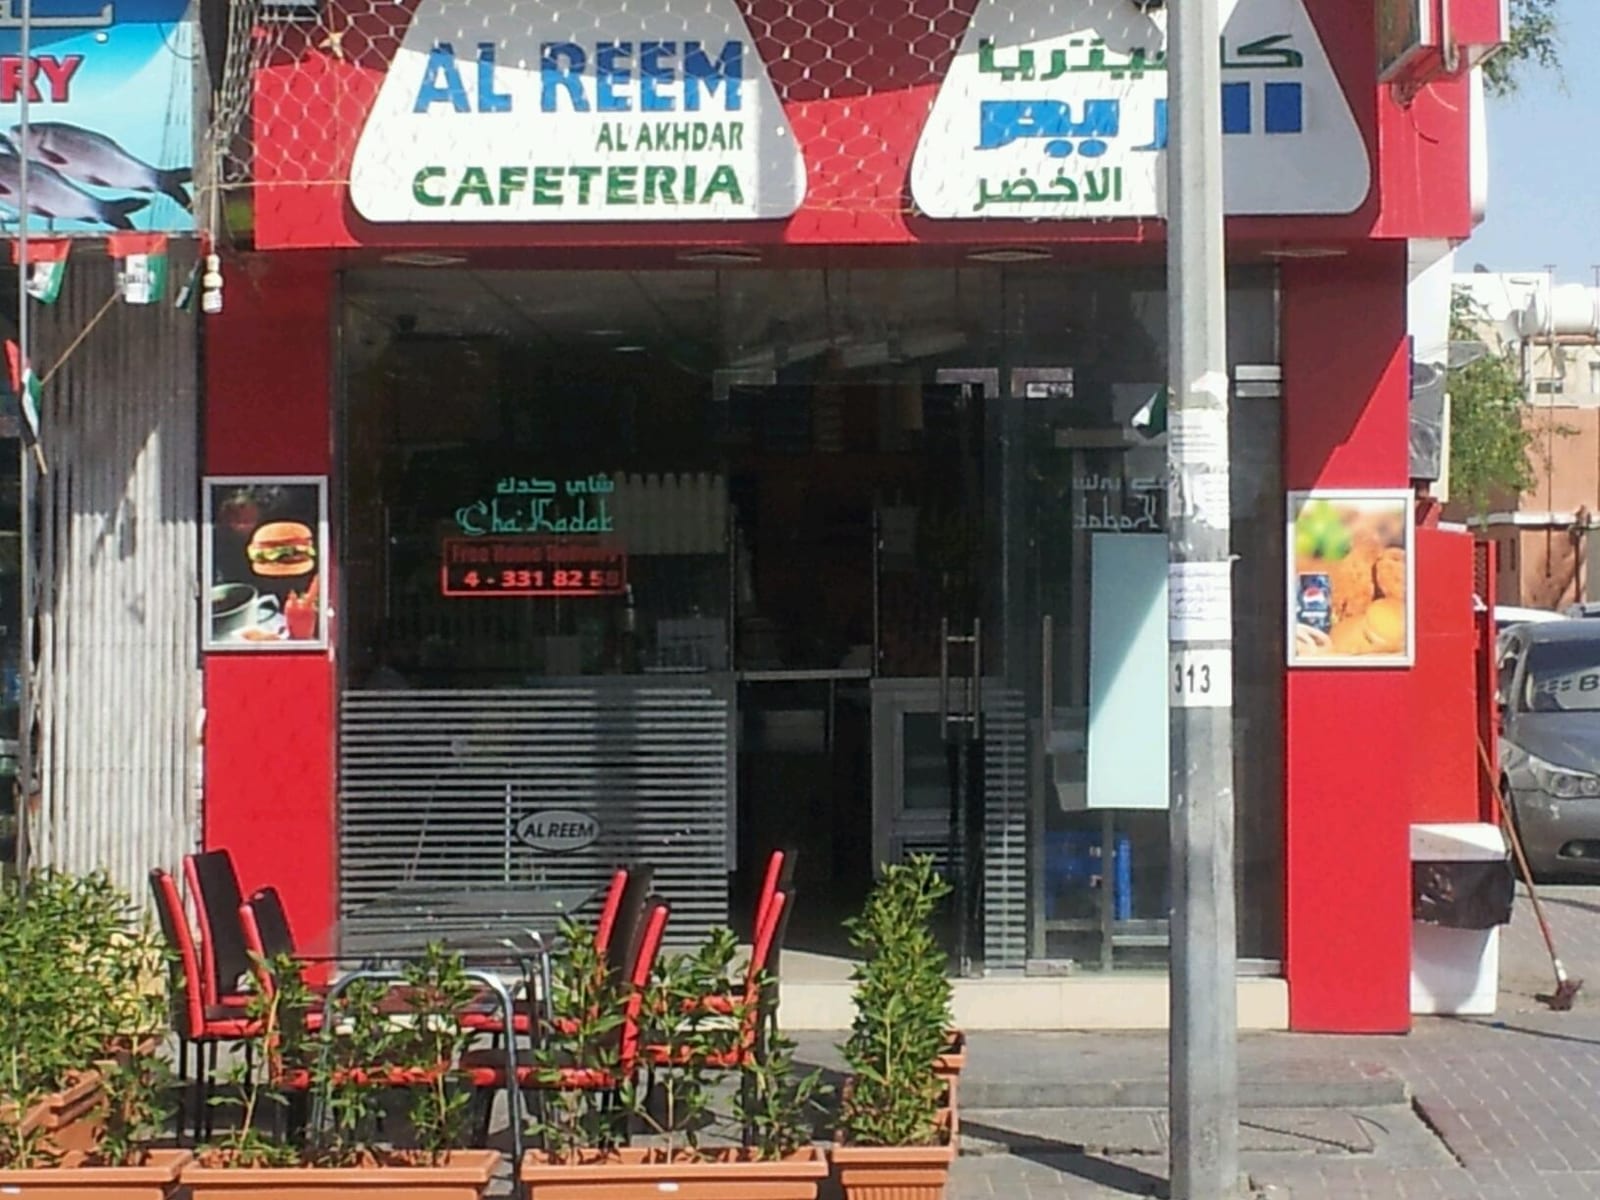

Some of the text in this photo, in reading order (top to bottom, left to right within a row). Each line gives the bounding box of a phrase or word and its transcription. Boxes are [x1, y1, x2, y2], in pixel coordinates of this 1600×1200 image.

[0, 54, 85, 103] RY
[412, 40, 744, 113] AL REEM
[595, 121, 745, 152] AL AKHDAR
[411, 164, 745, 206] CAFETERIA
[973, 167, 1122, 212] الاخضر
[502, 570, 544, 588] 331
[552, 569, 583, 588] 82
[1174, 663, 1211, 694] 313
[523, 822, 595, 838] AL REEM
